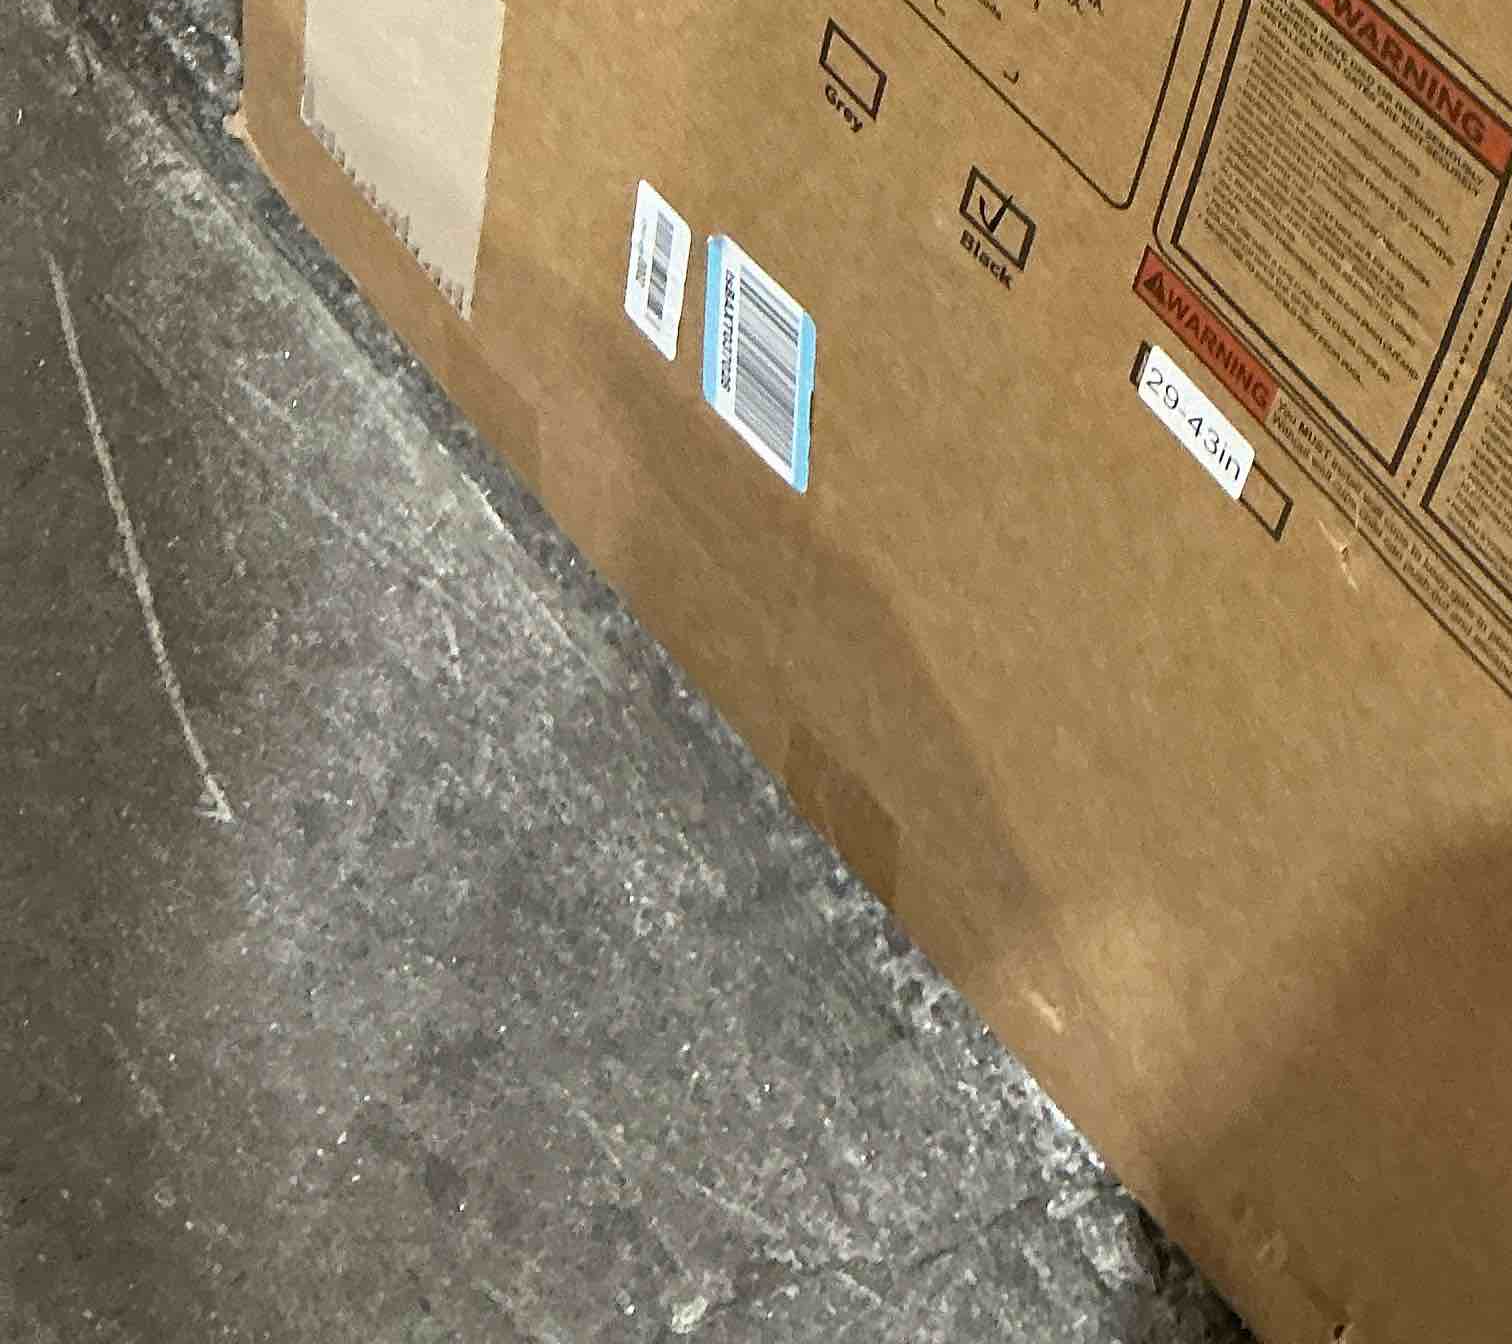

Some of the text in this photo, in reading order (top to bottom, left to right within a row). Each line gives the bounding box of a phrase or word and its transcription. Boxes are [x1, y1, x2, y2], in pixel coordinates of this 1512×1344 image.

[824, 82, 865, 134] Grey
[958, 228, 1013, 291] Black
[1165, 287, 1268, 410] WARNING
[1146, 366, 1241, 481] 29-43in
